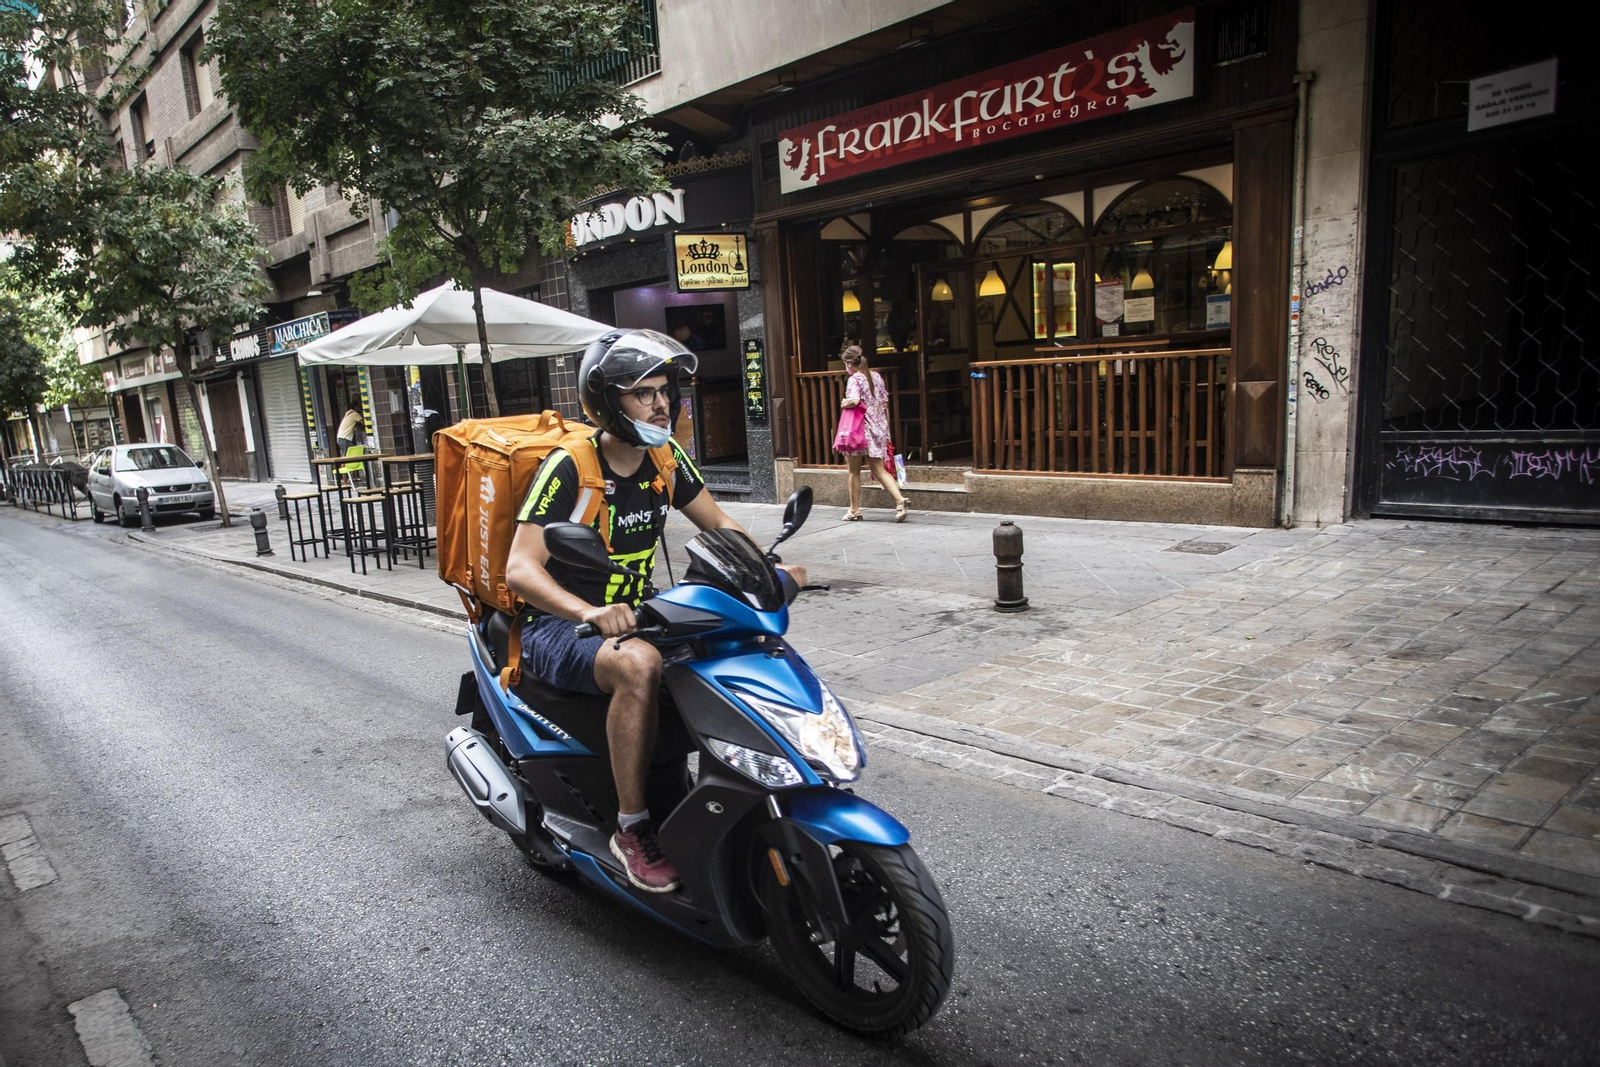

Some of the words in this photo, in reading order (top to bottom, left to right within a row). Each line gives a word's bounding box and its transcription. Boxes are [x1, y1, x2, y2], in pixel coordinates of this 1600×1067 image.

[1475, 98, 1507, 111] GARAJE
[1508, 88, 1550, 103] CERRADO
[1504, 82, 1532, 94] VENDE
[570, 188, 686, 247] ONDON
[679, 260, 732, 276] London
[230, 334, 261, 362] CRONOS
[479, 506, 489, 554] JUST
[480, 556, 490, 591] EAT
[548, 723, 571, 740] CITY
